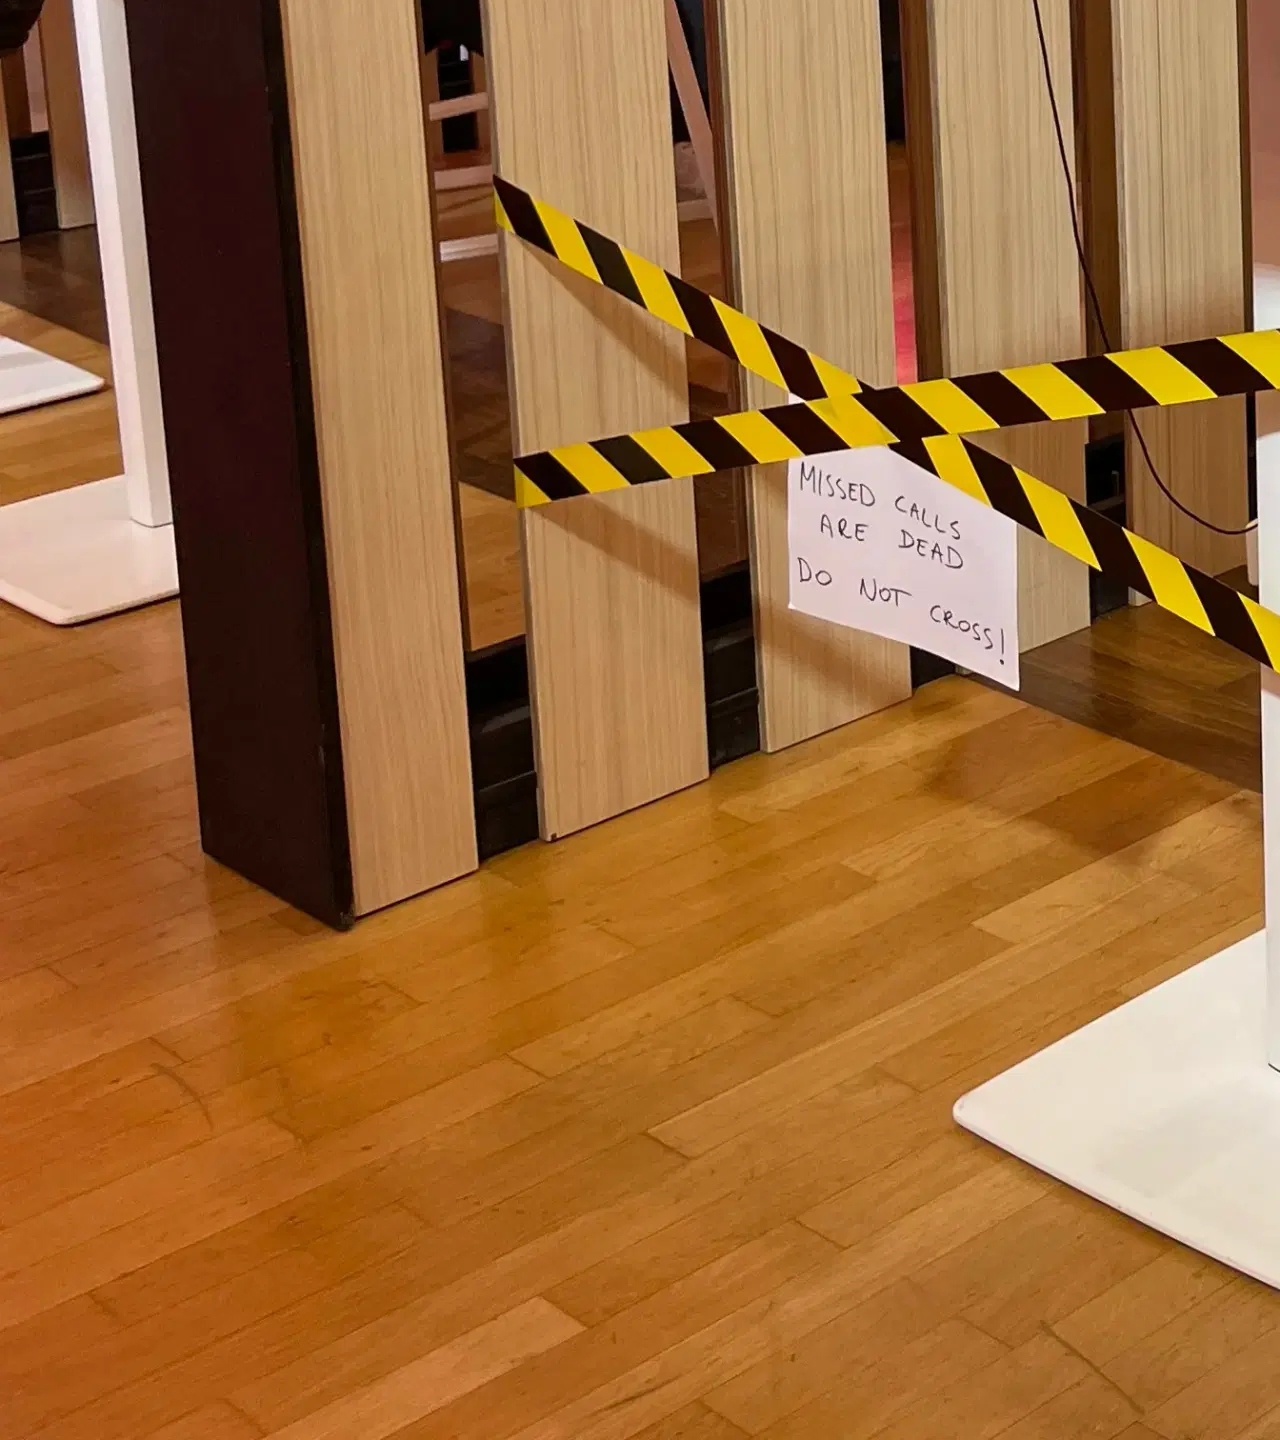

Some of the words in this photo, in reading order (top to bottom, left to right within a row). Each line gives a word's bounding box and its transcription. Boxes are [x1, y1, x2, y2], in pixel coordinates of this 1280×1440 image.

[800, 461, 876, 507] MISSED
[894, 495, 961, 540] CALLS
[820, 514, 869, 542] ARE
[898, 529, 964, 570] DEAD
[797, 557, 832, 586] DO
[859, 578, 913, 607] NOT
[929, 604, 1005, 665] CROSS!
